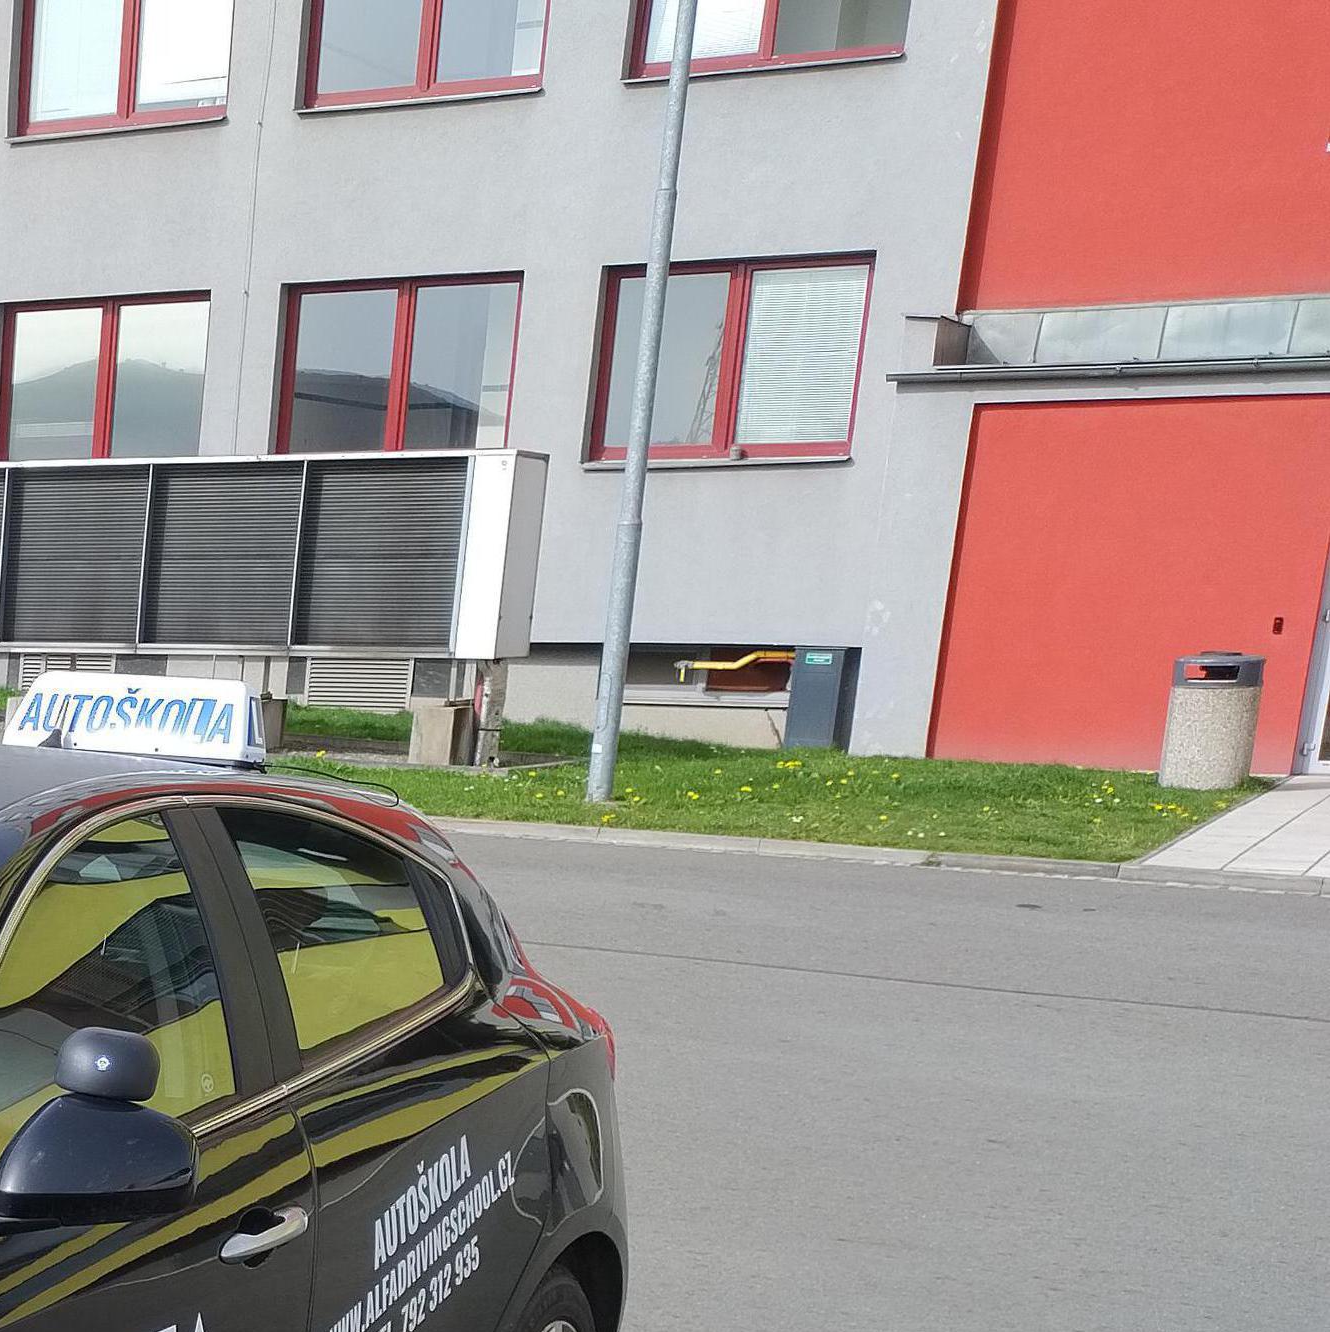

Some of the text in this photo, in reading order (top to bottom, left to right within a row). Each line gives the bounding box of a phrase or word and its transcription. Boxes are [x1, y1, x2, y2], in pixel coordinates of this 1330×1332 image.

[17, 687, 234, 744] AUTOŠKOLA
[374, 1134, 472, 1272] AUTOŠKOLA
[429, 1262, 453, 1312] 312
[454, 1234, 481, 1286] 935
